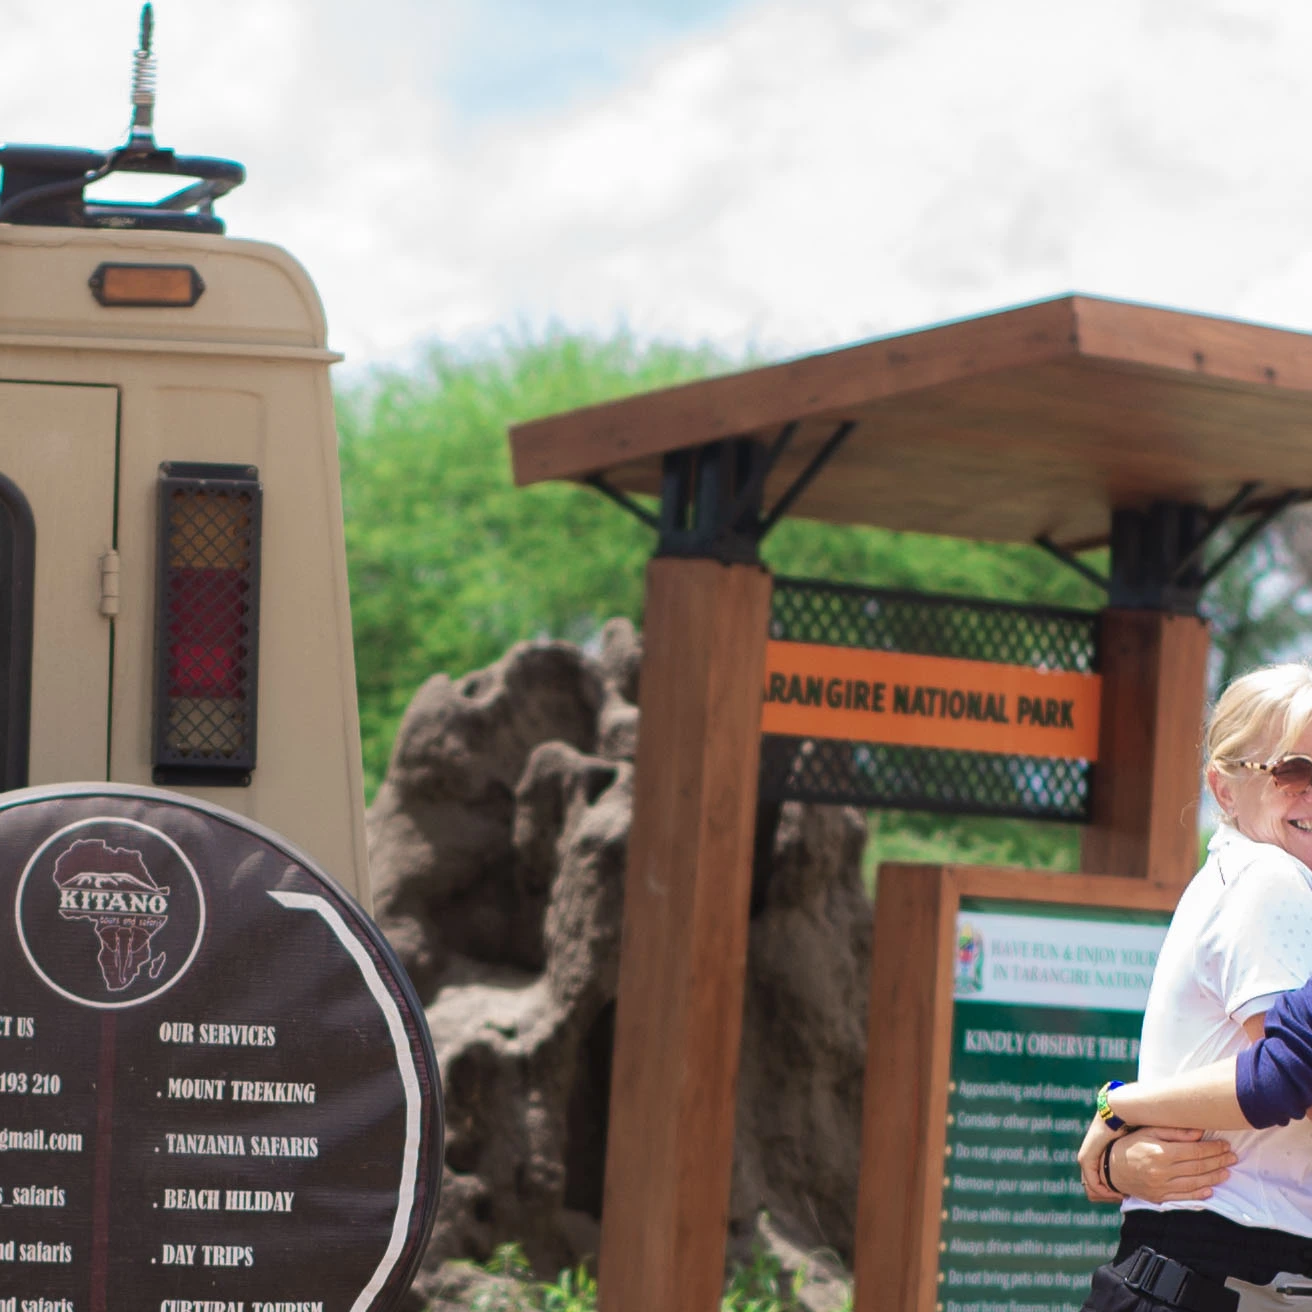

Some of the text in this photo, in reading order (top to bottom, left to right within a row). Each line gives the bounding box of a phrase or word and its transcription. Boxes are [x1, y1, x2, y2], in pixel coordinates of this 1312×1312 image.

[764, 671, 1075, 730] RANGIRE NATIONAL PARK
[59, 890, 167, 914] KITANO
[991, 940, 1032, 957] HAVE
[1036, 942, 1058, 960] FUN
[1063, 944, 1073, 961] &
[1077, 944, 1117, 965] ENJOY
[993, 963, 1008, 981] IN
[1012, 965, 1091, 985] TARANGIRE
[17, 1016, 34, 1038] US
[159, 1022, 276, 1047] OUR SERVICES
[964, 1029, 1024, 1054] KINDLY
[1028, 1033, 1096, 1059] OBSERVE
[1099, 1037, 1128, 1060] THE
[0, 1072, 28, 1093] 193
[31, 1073, 61, 1094] 210
[168, 1077, 316, 1104] MOUNT TREKKING
[959, 1081, 1021, 1104] Approaching
[1023, 1082, 1042, 1099] and
[1043, 1084, 1093, 1107] disturbing
[957, 1111, 1001, 1130] Consider
[1003, 1113, 1029, 1130] other
[1031, 1115, 1053, 1133] park
[165, 1132, 319, 1158] TANZANIA SAFARIS
[955, 1143, 970, 1158] Do
[972, 1144, 989, 1159] not
[1054, 1148, 1068, 1162] cut
[953, 1174, 993, 1190] Remove
[995, 1177, 1017, 1195] your
[1019, 1179, 1040, 1191] own
[1042, 1177, 1066, 1193] trash
[163, 1188, 294, 1213] BEACH HILIDAY
[952, 1206, 978, 1222] Drive
[979, 1208, 1010, 1223] within
[1073, 1211, 1099, 1226] roads
[1100, 1212, 1119, 1226] and
[19, 1241, 72, 1263] safaris
[162, 1243, 254, 1267] DAY TRIPS
[949, 1238, 985, 1256] Always
[986, 1239, 1011, 1253] drive
[1013, 1240, 1043, 1254] within
[1054, 1242, 1083, 1258] speed
[1085, 1242, 1106, 1256] limit
[948, 1269, 963, 1285] Do
[965, 1271, 982, 1286] not
[983, 1270, 1009, 1290] bring
[1011, 1272, 1032, 1289] pets
[1034, 1272, 1053, 1286] into
[1055, 1272, 1071, 1287] the
